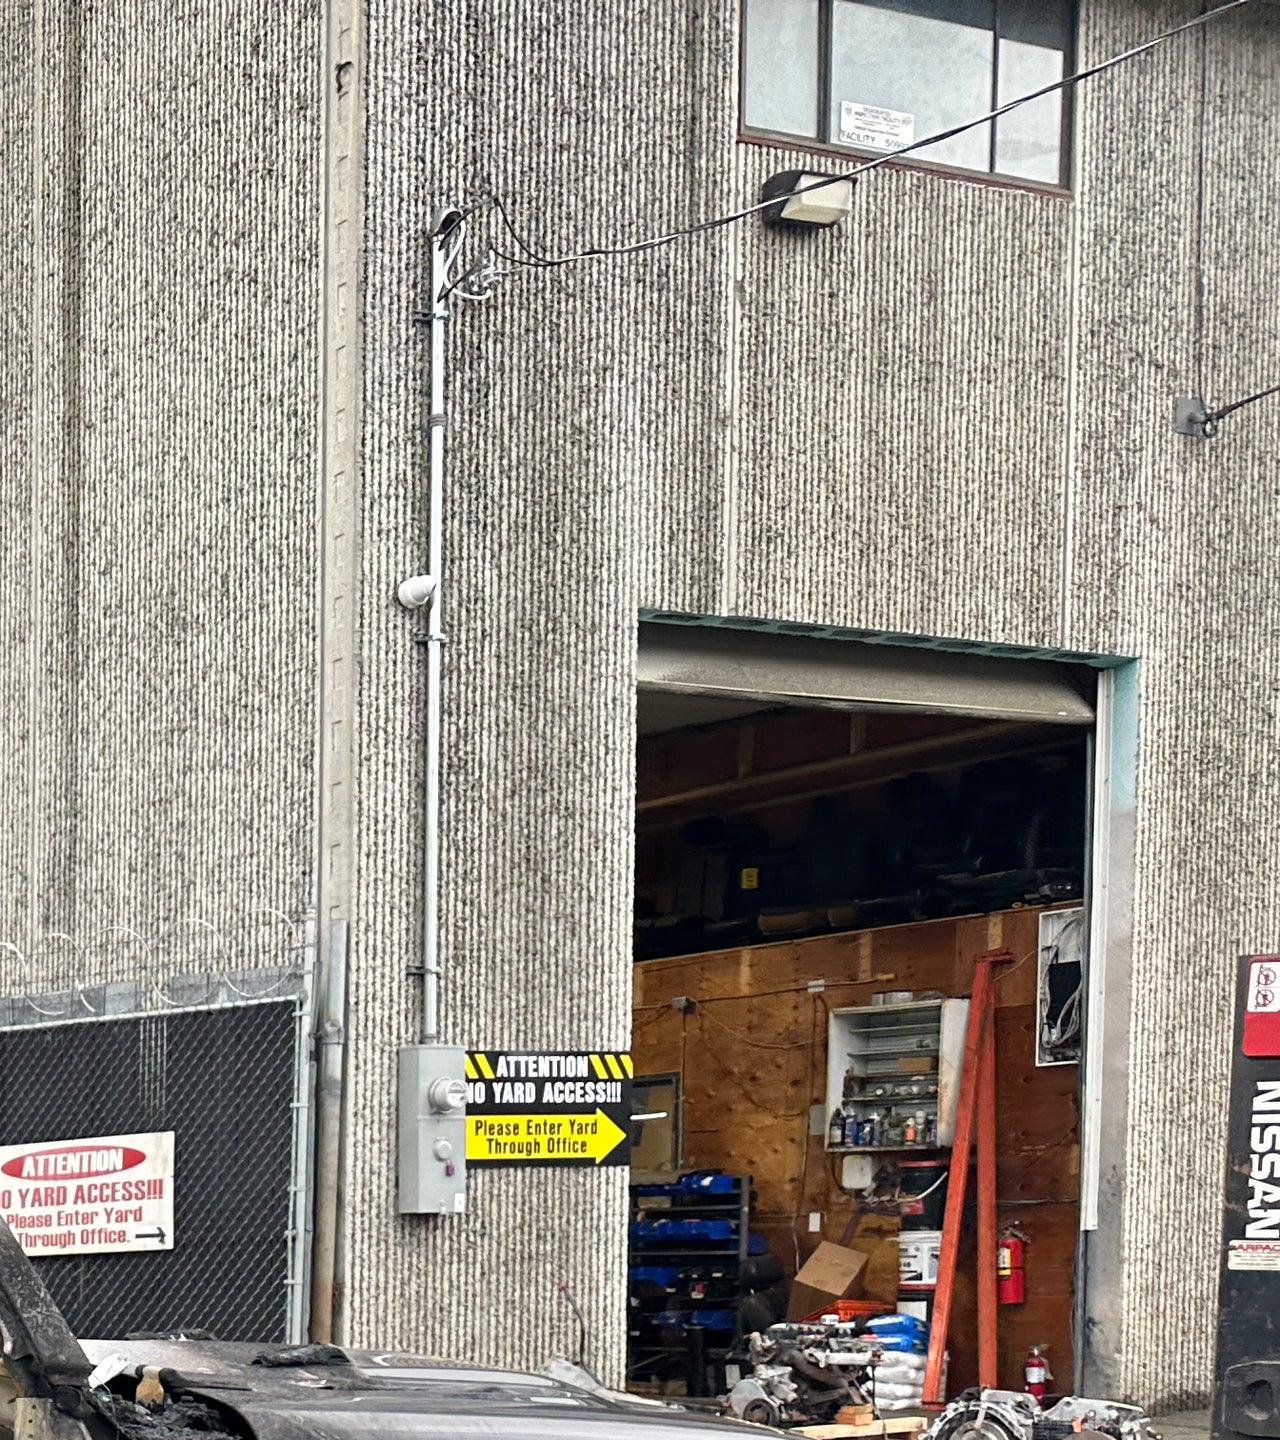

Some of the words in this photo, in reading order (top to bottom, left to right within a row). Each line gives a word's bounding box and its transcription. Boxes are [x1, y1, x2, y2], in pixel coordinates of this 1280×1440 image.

[496, 1055, 588, 1078] ATTENTION
[467, 1081, 486, 1104] NO
[492, 1081, 536, 1104] YARD
[542, 1081, 622, 1104] ACCESS!!!
[475, 1120, 520, 1136] Please
[526, 1119, 562, 1136] Enter
[568, 1118, 598, 1135] Yard
[486, 1138, 541, 1156] Through
[547, 1137, 587, 1154] Office
[21, 1148, 124, 1178] ATTENTION
[1245, 1080, 1280, 1239] NISSAN
[18, 1184, 67, 1209] YARD
[73, 1178, 164, 1206] ACCESS!!!
[6, 1213, 52, 1230] Please
[57, 1210, 99, 1228] Enter
[103, 1206, 143, 1224] Yard
[17, 1229, 76, 1249] Through
